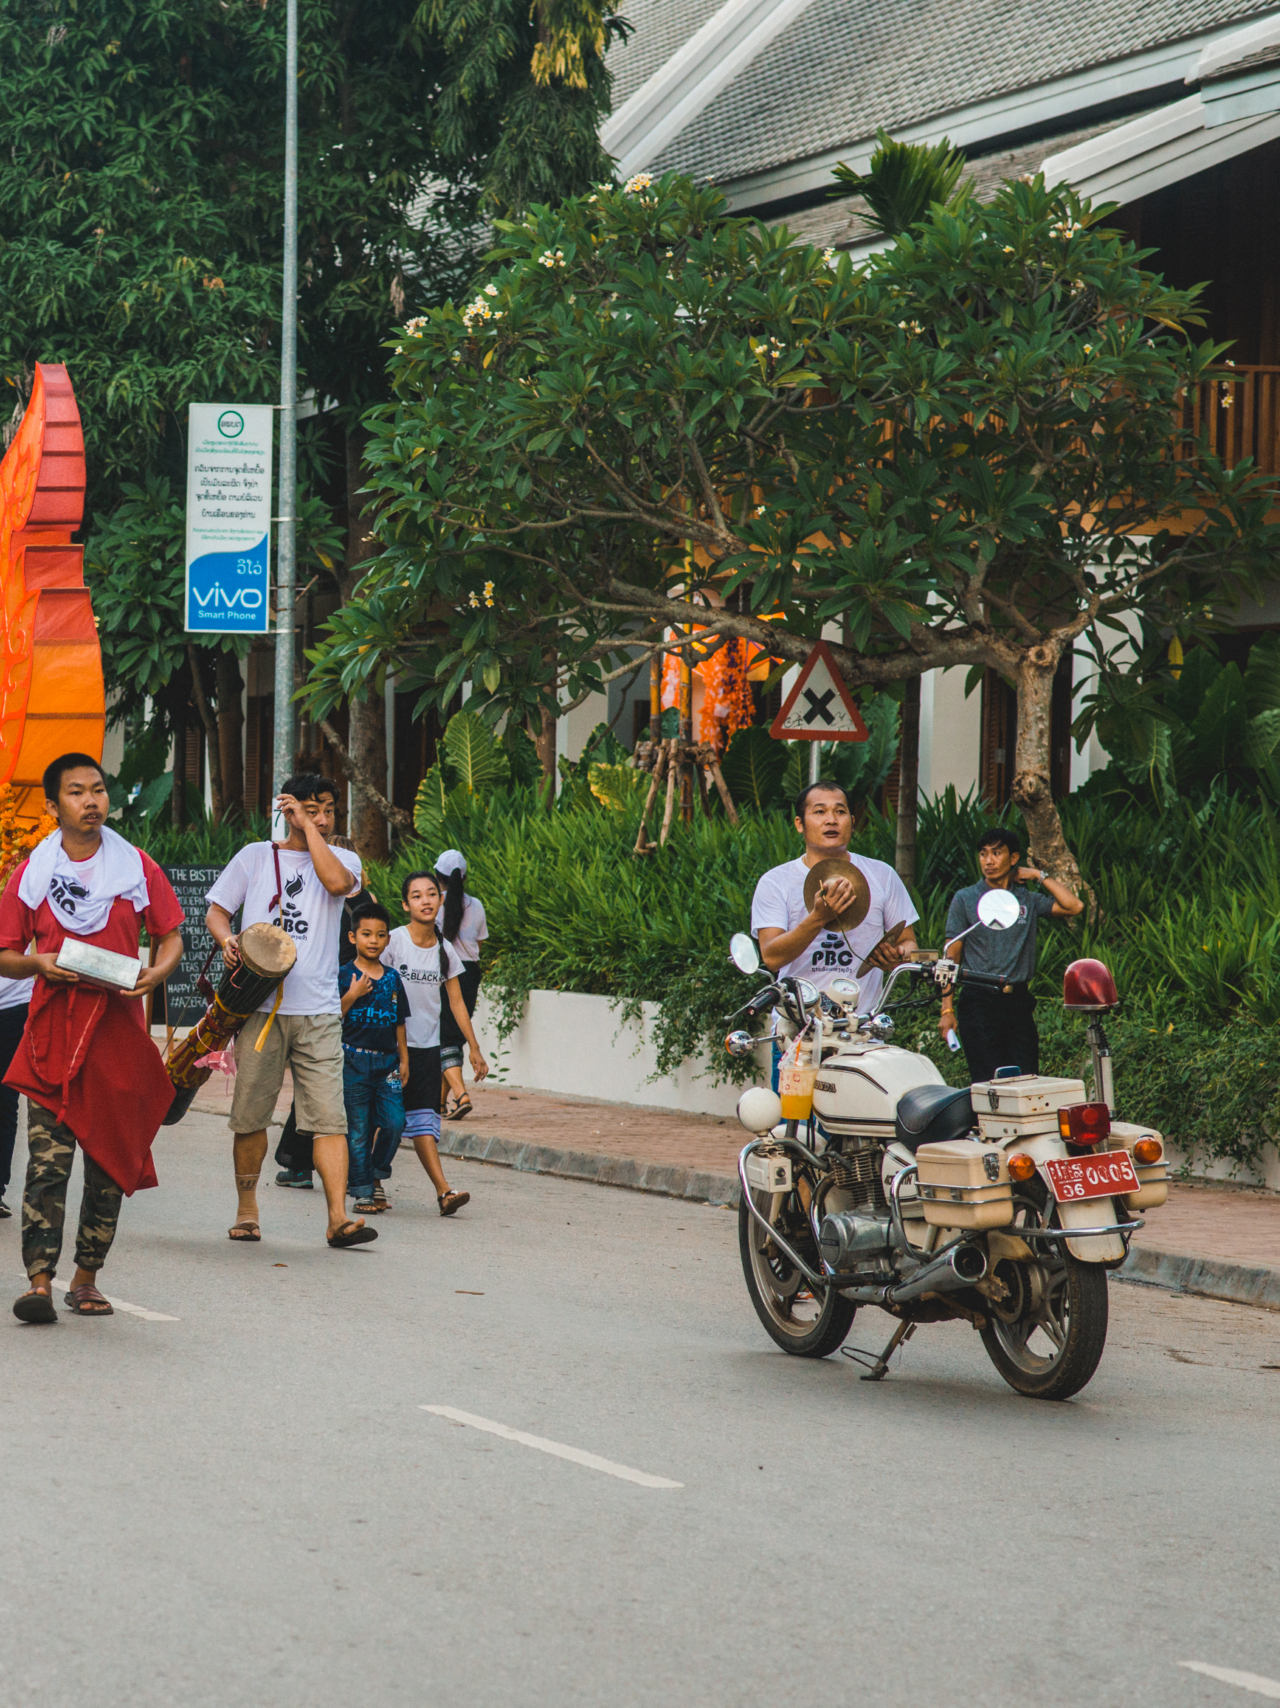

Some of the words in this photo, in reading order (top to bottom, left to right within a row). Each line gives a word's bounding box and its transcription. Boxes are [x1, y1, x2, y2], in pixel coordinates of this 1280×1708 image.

[192, 582, 262, 608] vivo
[198, 610, 224, 619] Smart
[227, 611, 256, 620] Phone
[168, 868, 188, 881] THE
[190, 869, 222, 882] BISTR
[183, 886, 202, 895] DAILY
[185, 926, 204, 935] MENU
[188, 951, 209, 960] DAILY
[811, 950, 853, 966] PBC
[181, 961, 200, 972] TEAS
[209, 961, 225, 972] COFF
[410, 972, 438, 982] BLACK
[167, 984, 191, 993] HAPPY
[813, 1079, 837, 1093] ONDA
[1086, 1162, 1133, 1185] 0005
